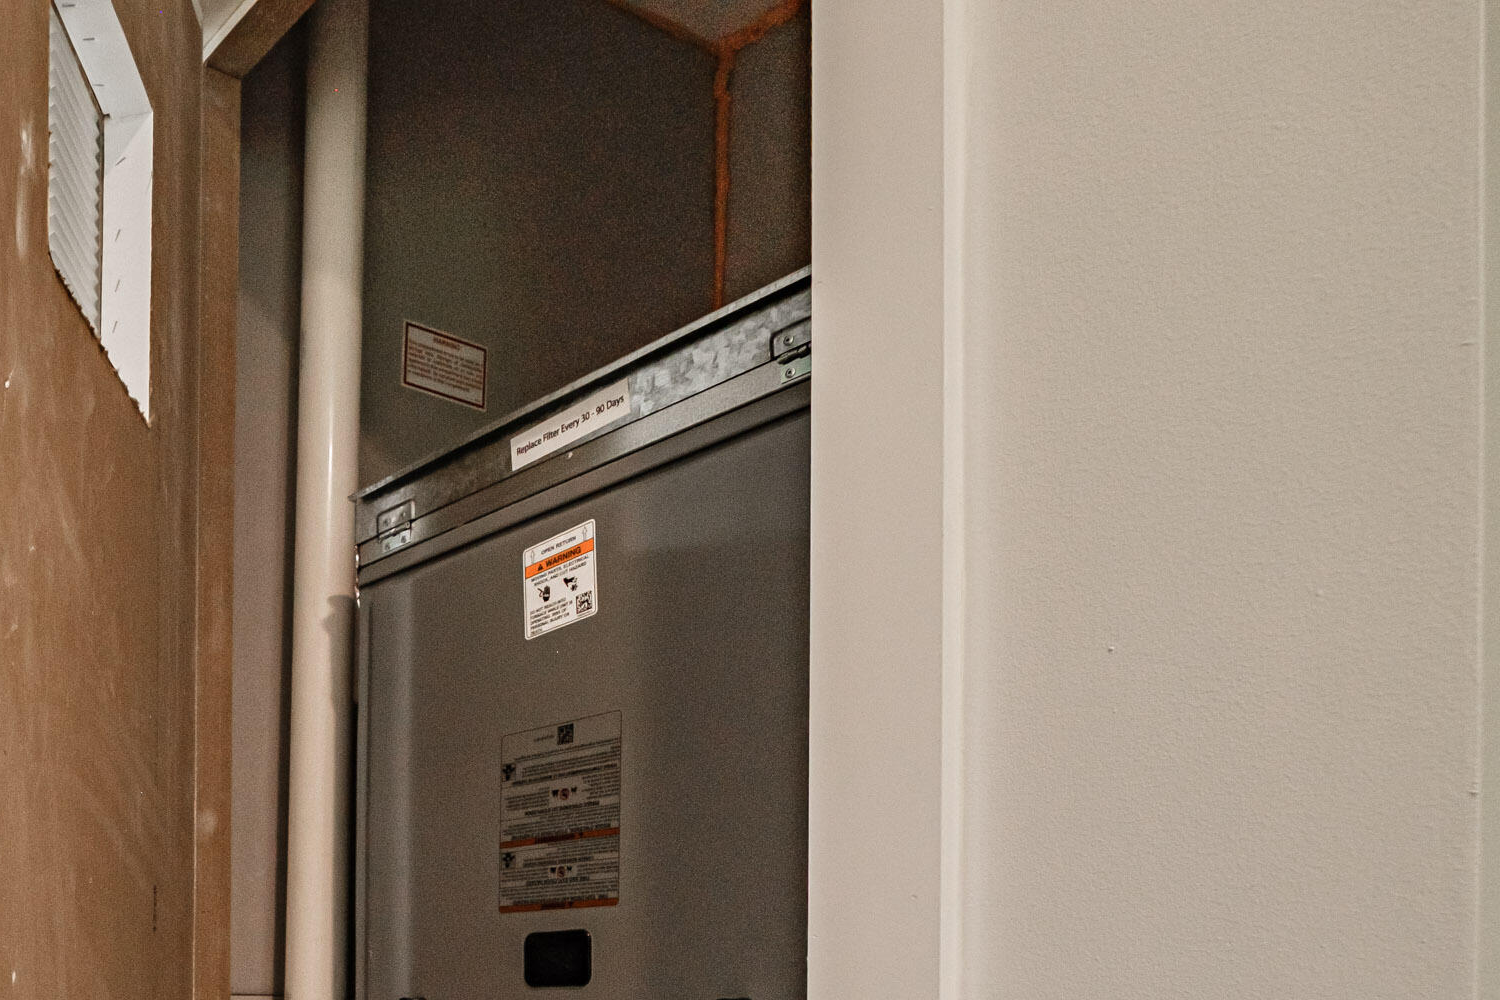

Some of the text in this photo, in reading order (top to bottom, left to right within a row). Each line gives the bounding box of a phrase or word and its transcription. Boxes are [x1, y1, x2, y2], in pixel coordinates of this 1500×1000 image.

[516, 438, 542, 456] Replace
[542, 429, 560, 442] Filter
[561, 418, 580, 433] Every
[581, 412, 590, 423] 30
[596, 404, 605, 415] 90
[606, 395, 625, 410] Days
[541, 536, 576, 555] OPEN RETURN
[546, 546, 581, 568] WARNING
